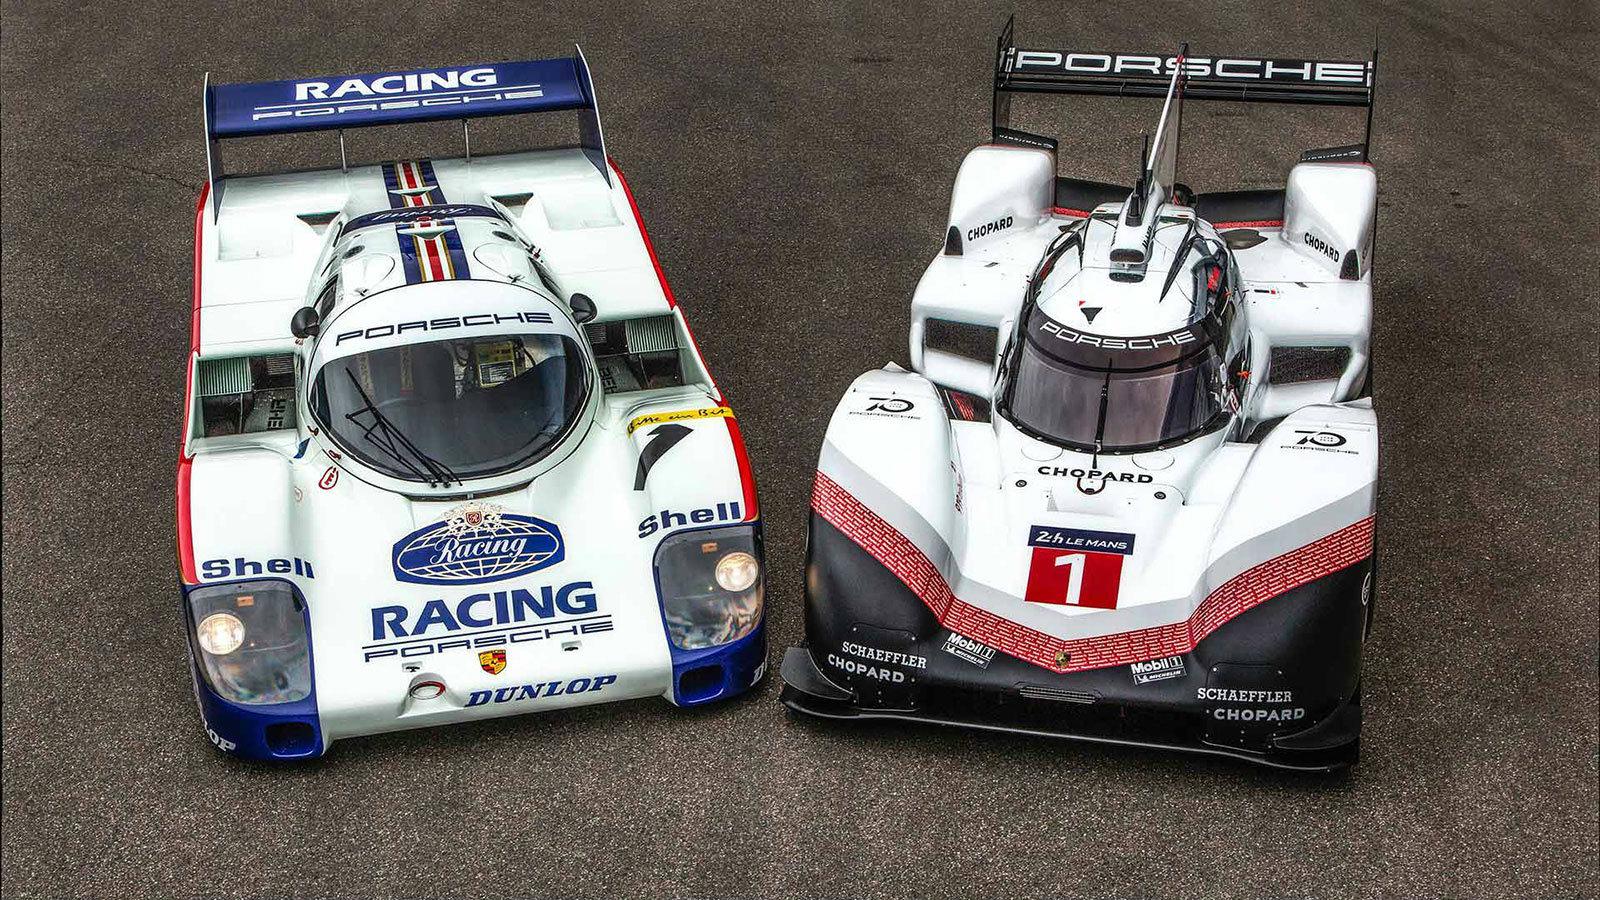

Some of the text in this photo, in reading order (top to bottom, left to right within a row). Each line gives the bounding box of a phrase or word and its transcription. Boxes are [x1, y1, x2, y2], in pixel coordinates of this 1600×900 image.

[1016, 51, 1364, 82] PORSCHE
[295, 68, 498, 101] RACING
[253, 90, 544, 121] PORSCHE
[967, 216, 1014, 241] CHOPARD
[1304, 232, 1340, 263] CHOPARD
[335, 312, 553, 347] PORSCHE
[1040, 321, 1196, 350] PORSCHE
[866, 397, 914, 412] 70
[1294, 430, 1347, 447] 70
[1037, 465, 1153, 484] CHOPARD
[639, 501, 742, 539] Shell
[430, 535, 528, 565] Racing
[1035, 530, 1128, 550] 24h LE MANS
[202, 558, 315, 580] Shell
[1055, 553, 1086, 605] 1
[371, 581, 598, 641] RACING
[364, 620, 614, 663] PORSCHE
[842, 641, 927, 669] SCHAEFFLER
[947, 632, 984, 653] Mobil
[828, 654, 905, 683] CHOPARD
[1130, 658, 1170, 675] Mobil
[464, 674, 618, 708] DUNLOP
[1197, 687, 1292, 703] SCHAEFFLER
[1213, 708, 1305, 721] CHOPARD
